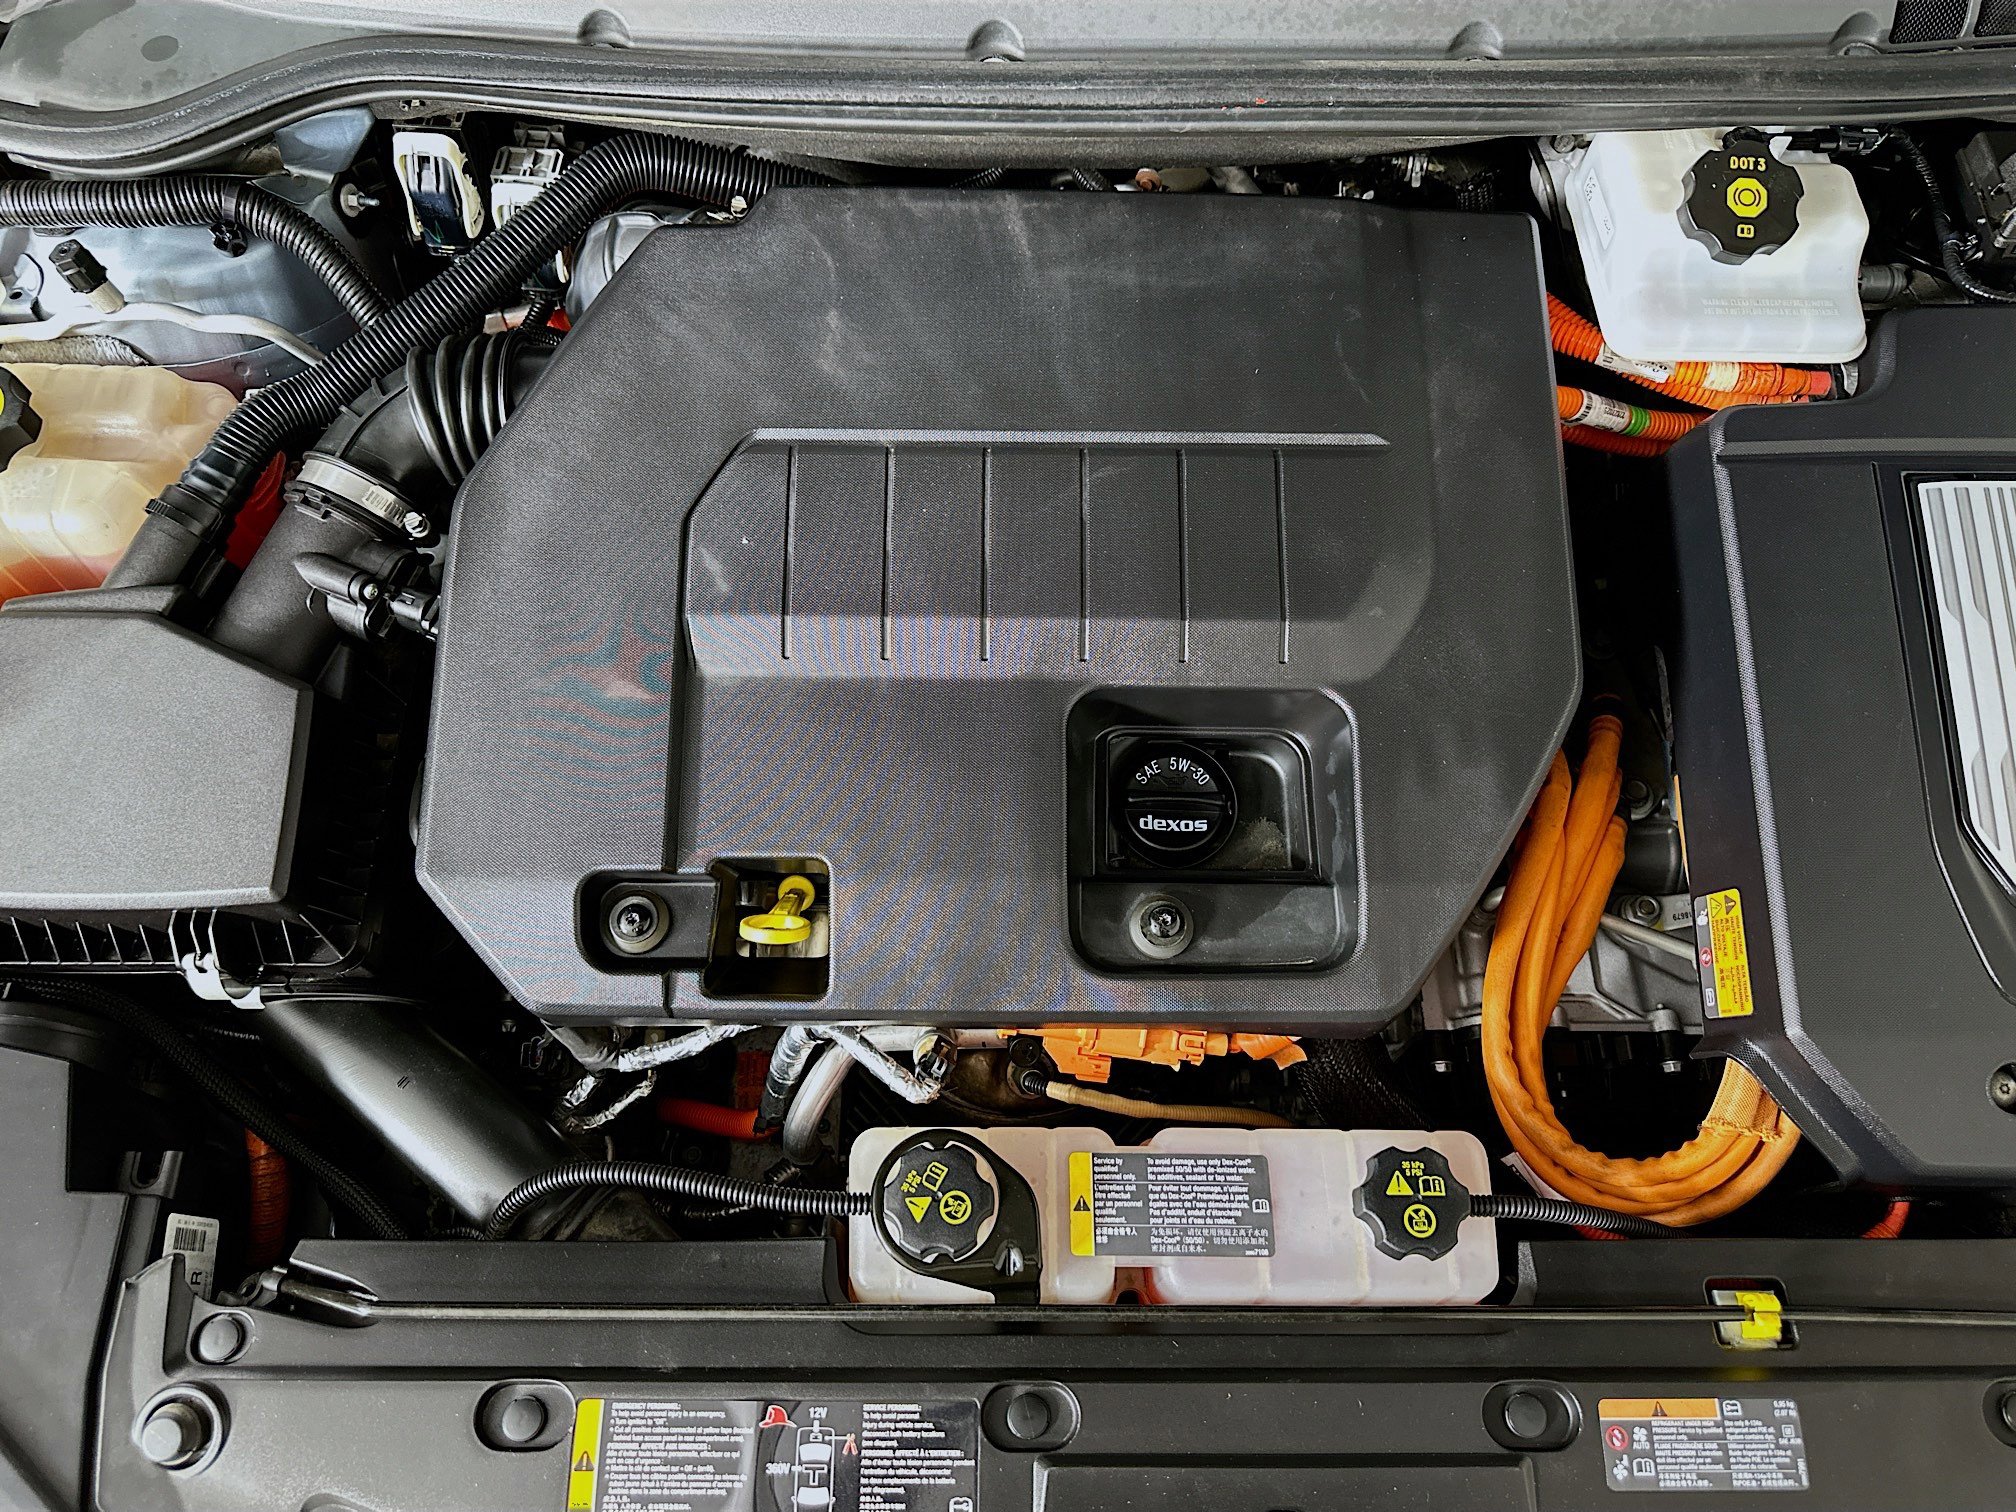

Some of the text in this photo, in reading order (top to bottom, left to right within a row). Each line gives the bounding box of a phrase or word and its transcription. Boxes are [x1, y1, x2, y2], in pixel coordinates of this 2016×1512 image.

[1730, 156, 1766, 171] DOT 3
[1136, 756, 1210, 786] SAE 5W-30
[1139, 814, 1208, 832] dexos
[1411, 1161, 1424, 1169] kPa
[808, 1406, 828, 1418] 12V
[1633, 1441, 1650, 1450] AUTO
[765, 1462, 790, 1474] 360V
